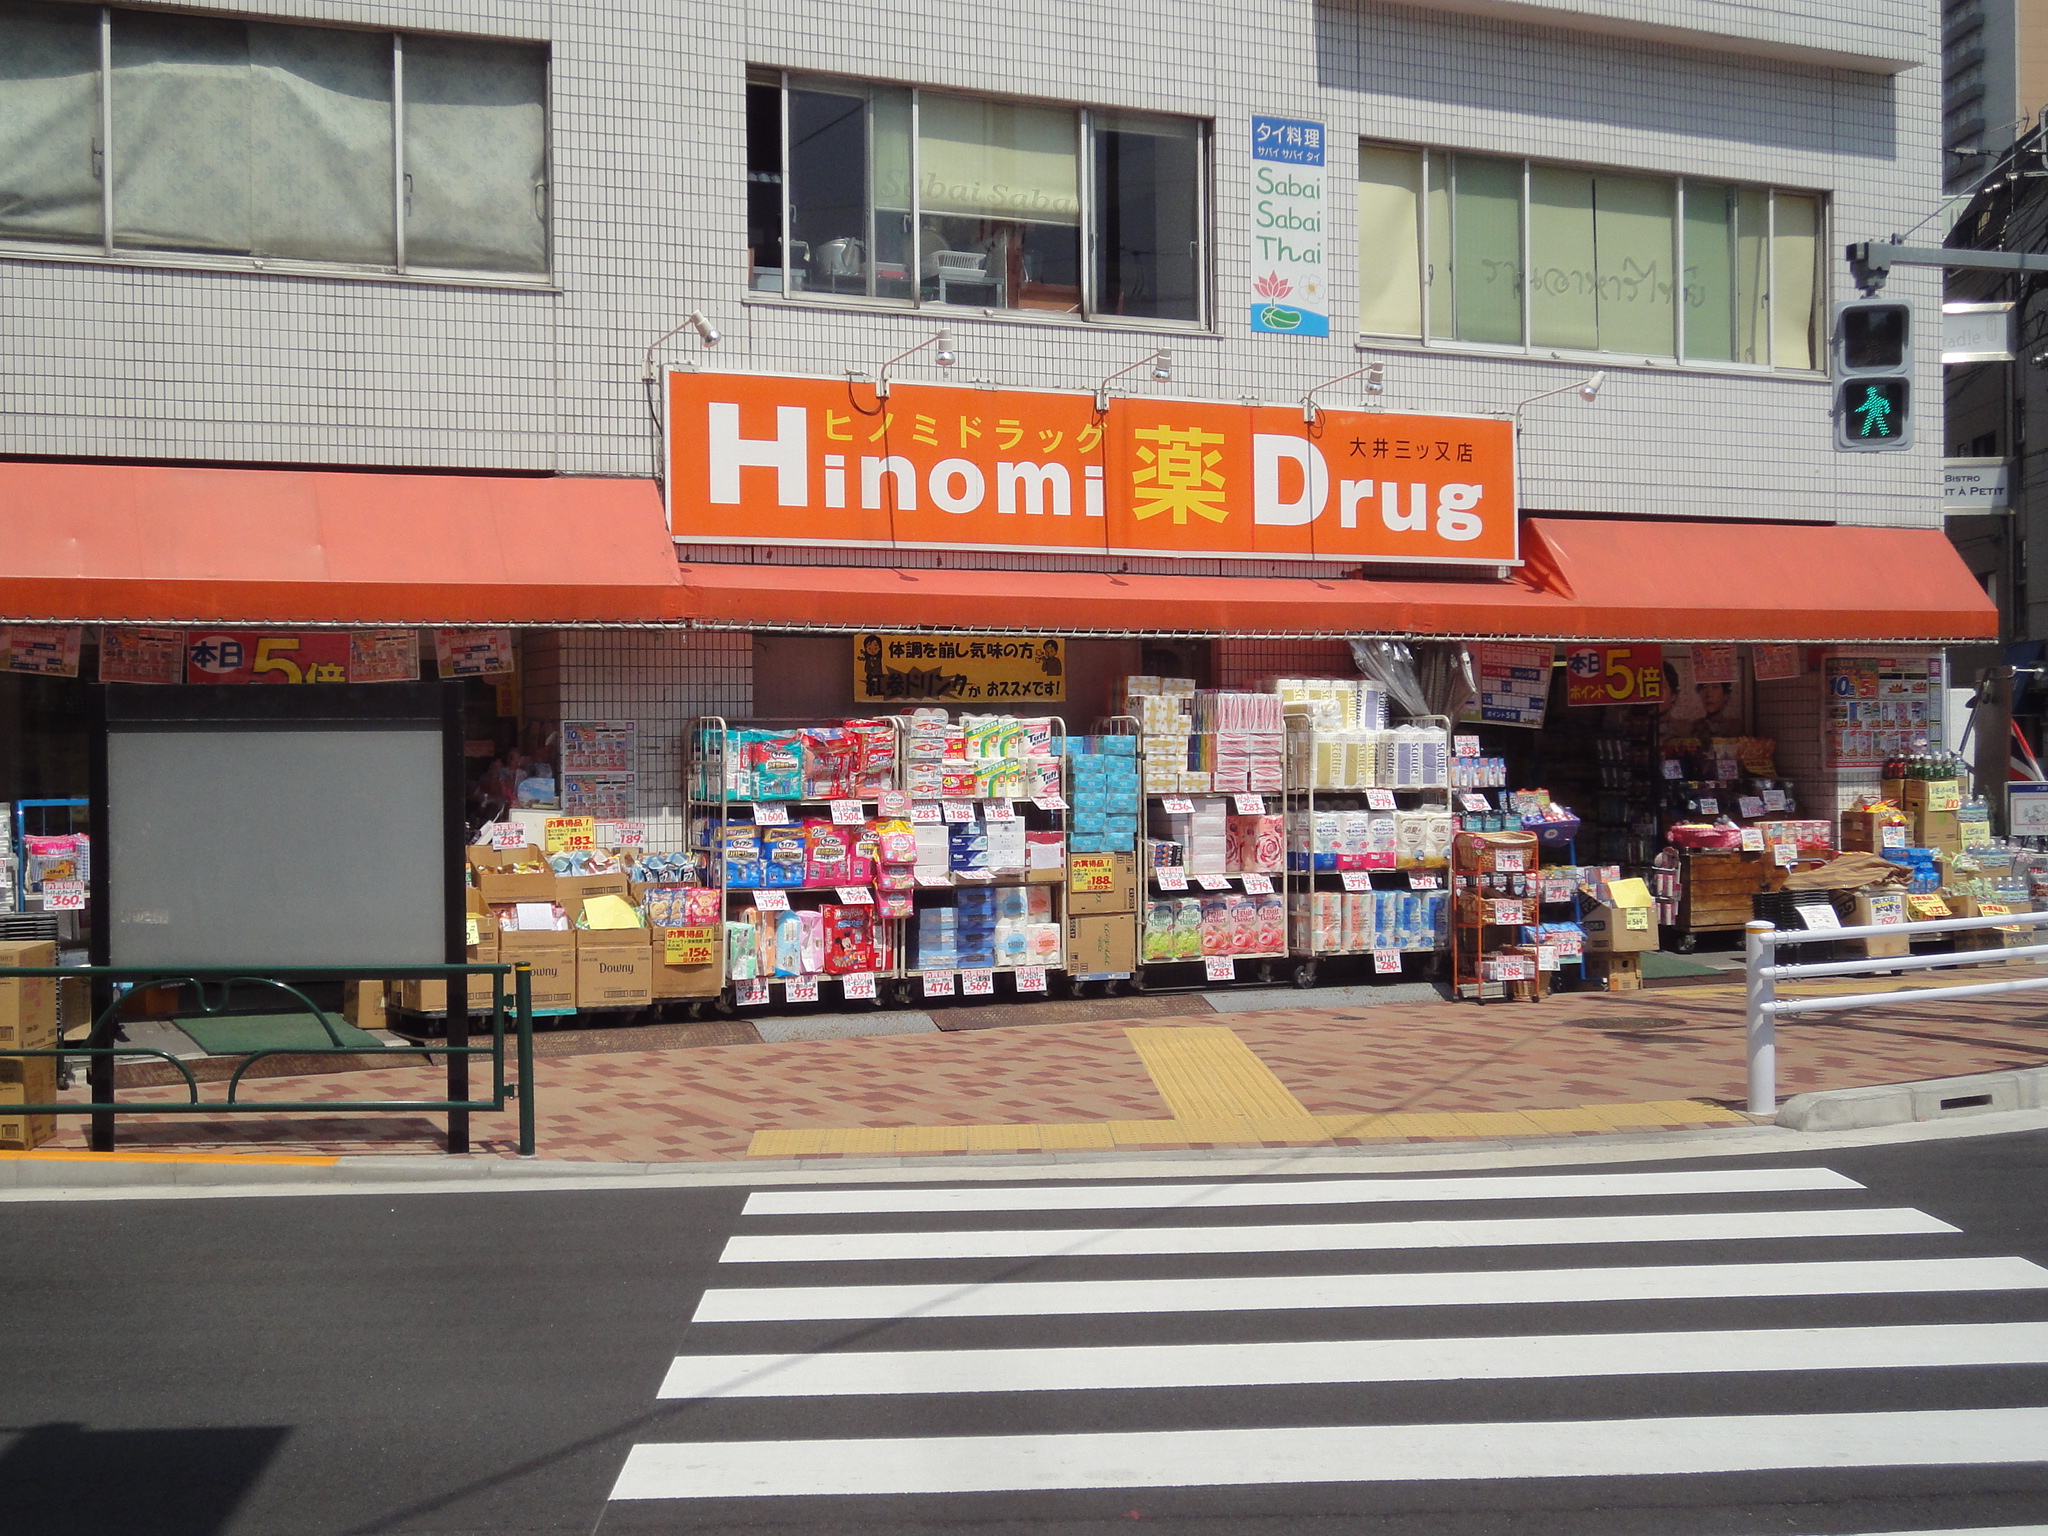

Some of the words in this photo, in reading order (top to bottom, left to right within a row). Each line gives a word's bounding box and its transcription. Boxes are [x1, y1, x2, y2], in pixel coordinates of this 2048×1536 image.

[1257, 122, 1320, 148] タイ料理
[1258, 146, 1279, 158] サバイ
[1282, 149, 1303, 160] サバイ
[1306, 152, 1320, 162] タイ
[1256, 167, 1320, 199] Sabai
[987, 184, 1078, 214] Saba
[1256, 200, 1320, 232] Sabai
[1256, 235, 1321, 264] Thai
[826, 409, 1107, 453] ヒノミドラッグ
[708, 402, 1104, 516] Hinomi
[1132, 424, 1230, 524] 薬
[1253, 433, 1483, 541] Drug
[889, 641, 1034, 659] 体調を崩し気味の方
[190, 641, 243, 669] 本日
[1568, 653, 1600, 673] 本日
[1570, 685, 1605, 699] ポイント
[1027, 732, 1047, 742] Tuff
[1331, 742, 1341, 775] scottie
[1387, 743, 1395, 774] scottie
[1411, 743, 1419, 774] scottie
[1437, 743, 1446, 773] scottie
[1041, 771, 1057, 781] Tuff
[1945, 799, 1958, 808] 100
[762, 812, 783, 821] 1600
[839, 813, 859, 821] 1504
[916, 810, 936, 818] 283
[952, 810, 970, 818] 188
[501, 836, 521, 845] 283
[569, 836, 589, 845] 183
[620, 835, 641, 844] 189
[1091, 876, 1110, 884] 188
[1350, 879, 1366, 887] 379
[1416, 878, 1431, 886] 379
[1251, 883, 1269, 891] 379
[1551, 890, 1567, 898] 474
[52, 895, 79, 906] 360
[1235, 915, 1255, 923] Basket
[688, 948, 708, 957] 156
[530, 967, 558, 978] owny
[599, 963, 634, 974] Downy
[1213, 968, 1230, 976] 283
[1503, 968, 1520, 976] 188
[930, 983, 950, 992] 474
[970, 981, 988, 990] 569
[1023, 979, 1041, 988] 283
[794, 988, 814, 997] 933
[851, 985, 871, 994] 933
[745, 991, 765, 999] 933
